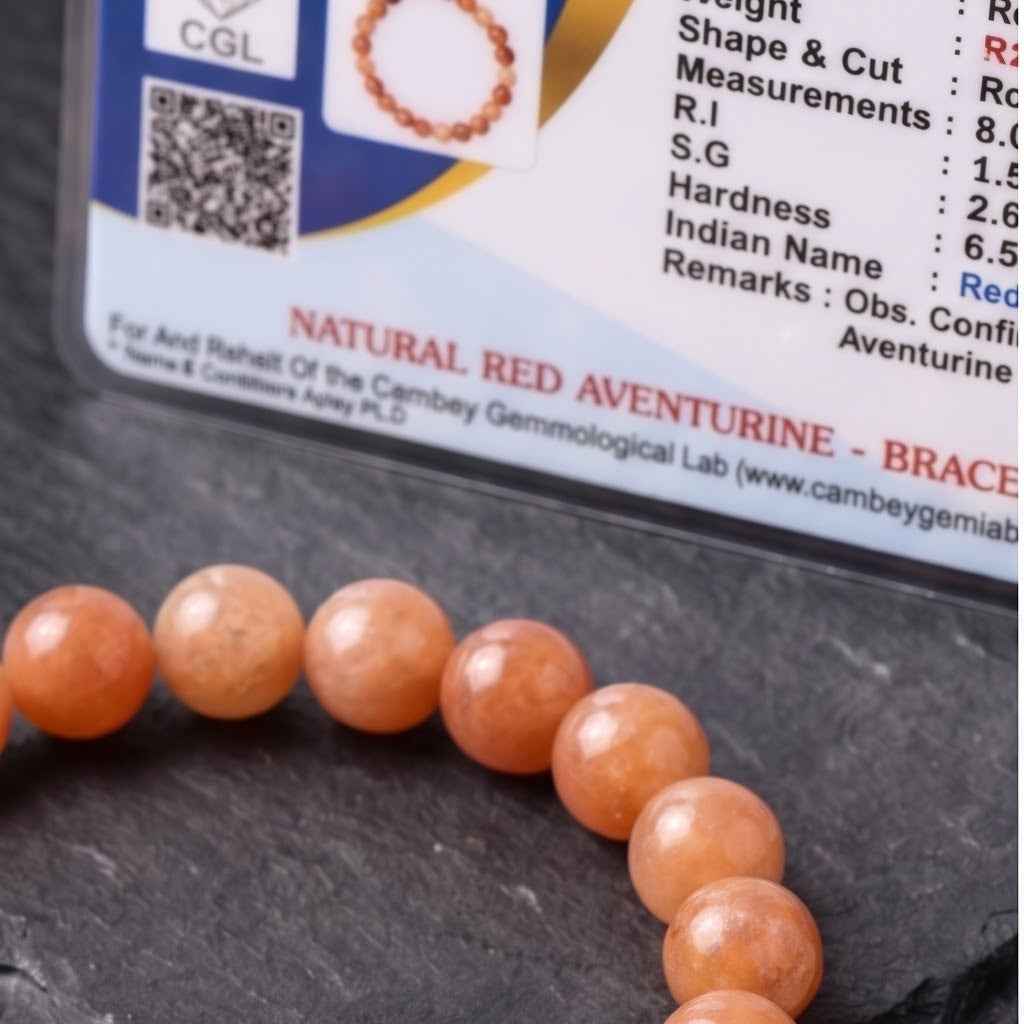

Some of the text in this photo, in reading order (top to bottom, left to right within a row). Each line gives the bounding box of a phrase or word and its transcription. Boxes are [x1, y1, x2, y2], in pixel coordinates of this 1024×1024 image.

[179, 20, 264, 65] CGL
[682, 0, 801, 23] eight
[986, 0, 1018, 24] R
[679, 14, 787, 61] Shape
[801, 39, 825, 68] &
[842, 47, 903, 84] Cut
[677, 53, 930, 130] Measurements
[671, 133, 728, 167] S.G
[666, 210, 769, 256] Indian
[785, 234, 882, 279] Name
[669, 171, 1018, 267] Hardness 6.5
[663, 248, 810, 302] Remarks
[845, 288, 915, 325] Obs.
[290, 306, 465, 374] NATURAL
[483, 351, 562, 392] RED
[578, 375, 833, 456] AVENTURINE
[839, 326, 1011, 383] Aventurine
[486, 401, 674, 464] Gemmological
[682, 446, 728, 477] Lab
